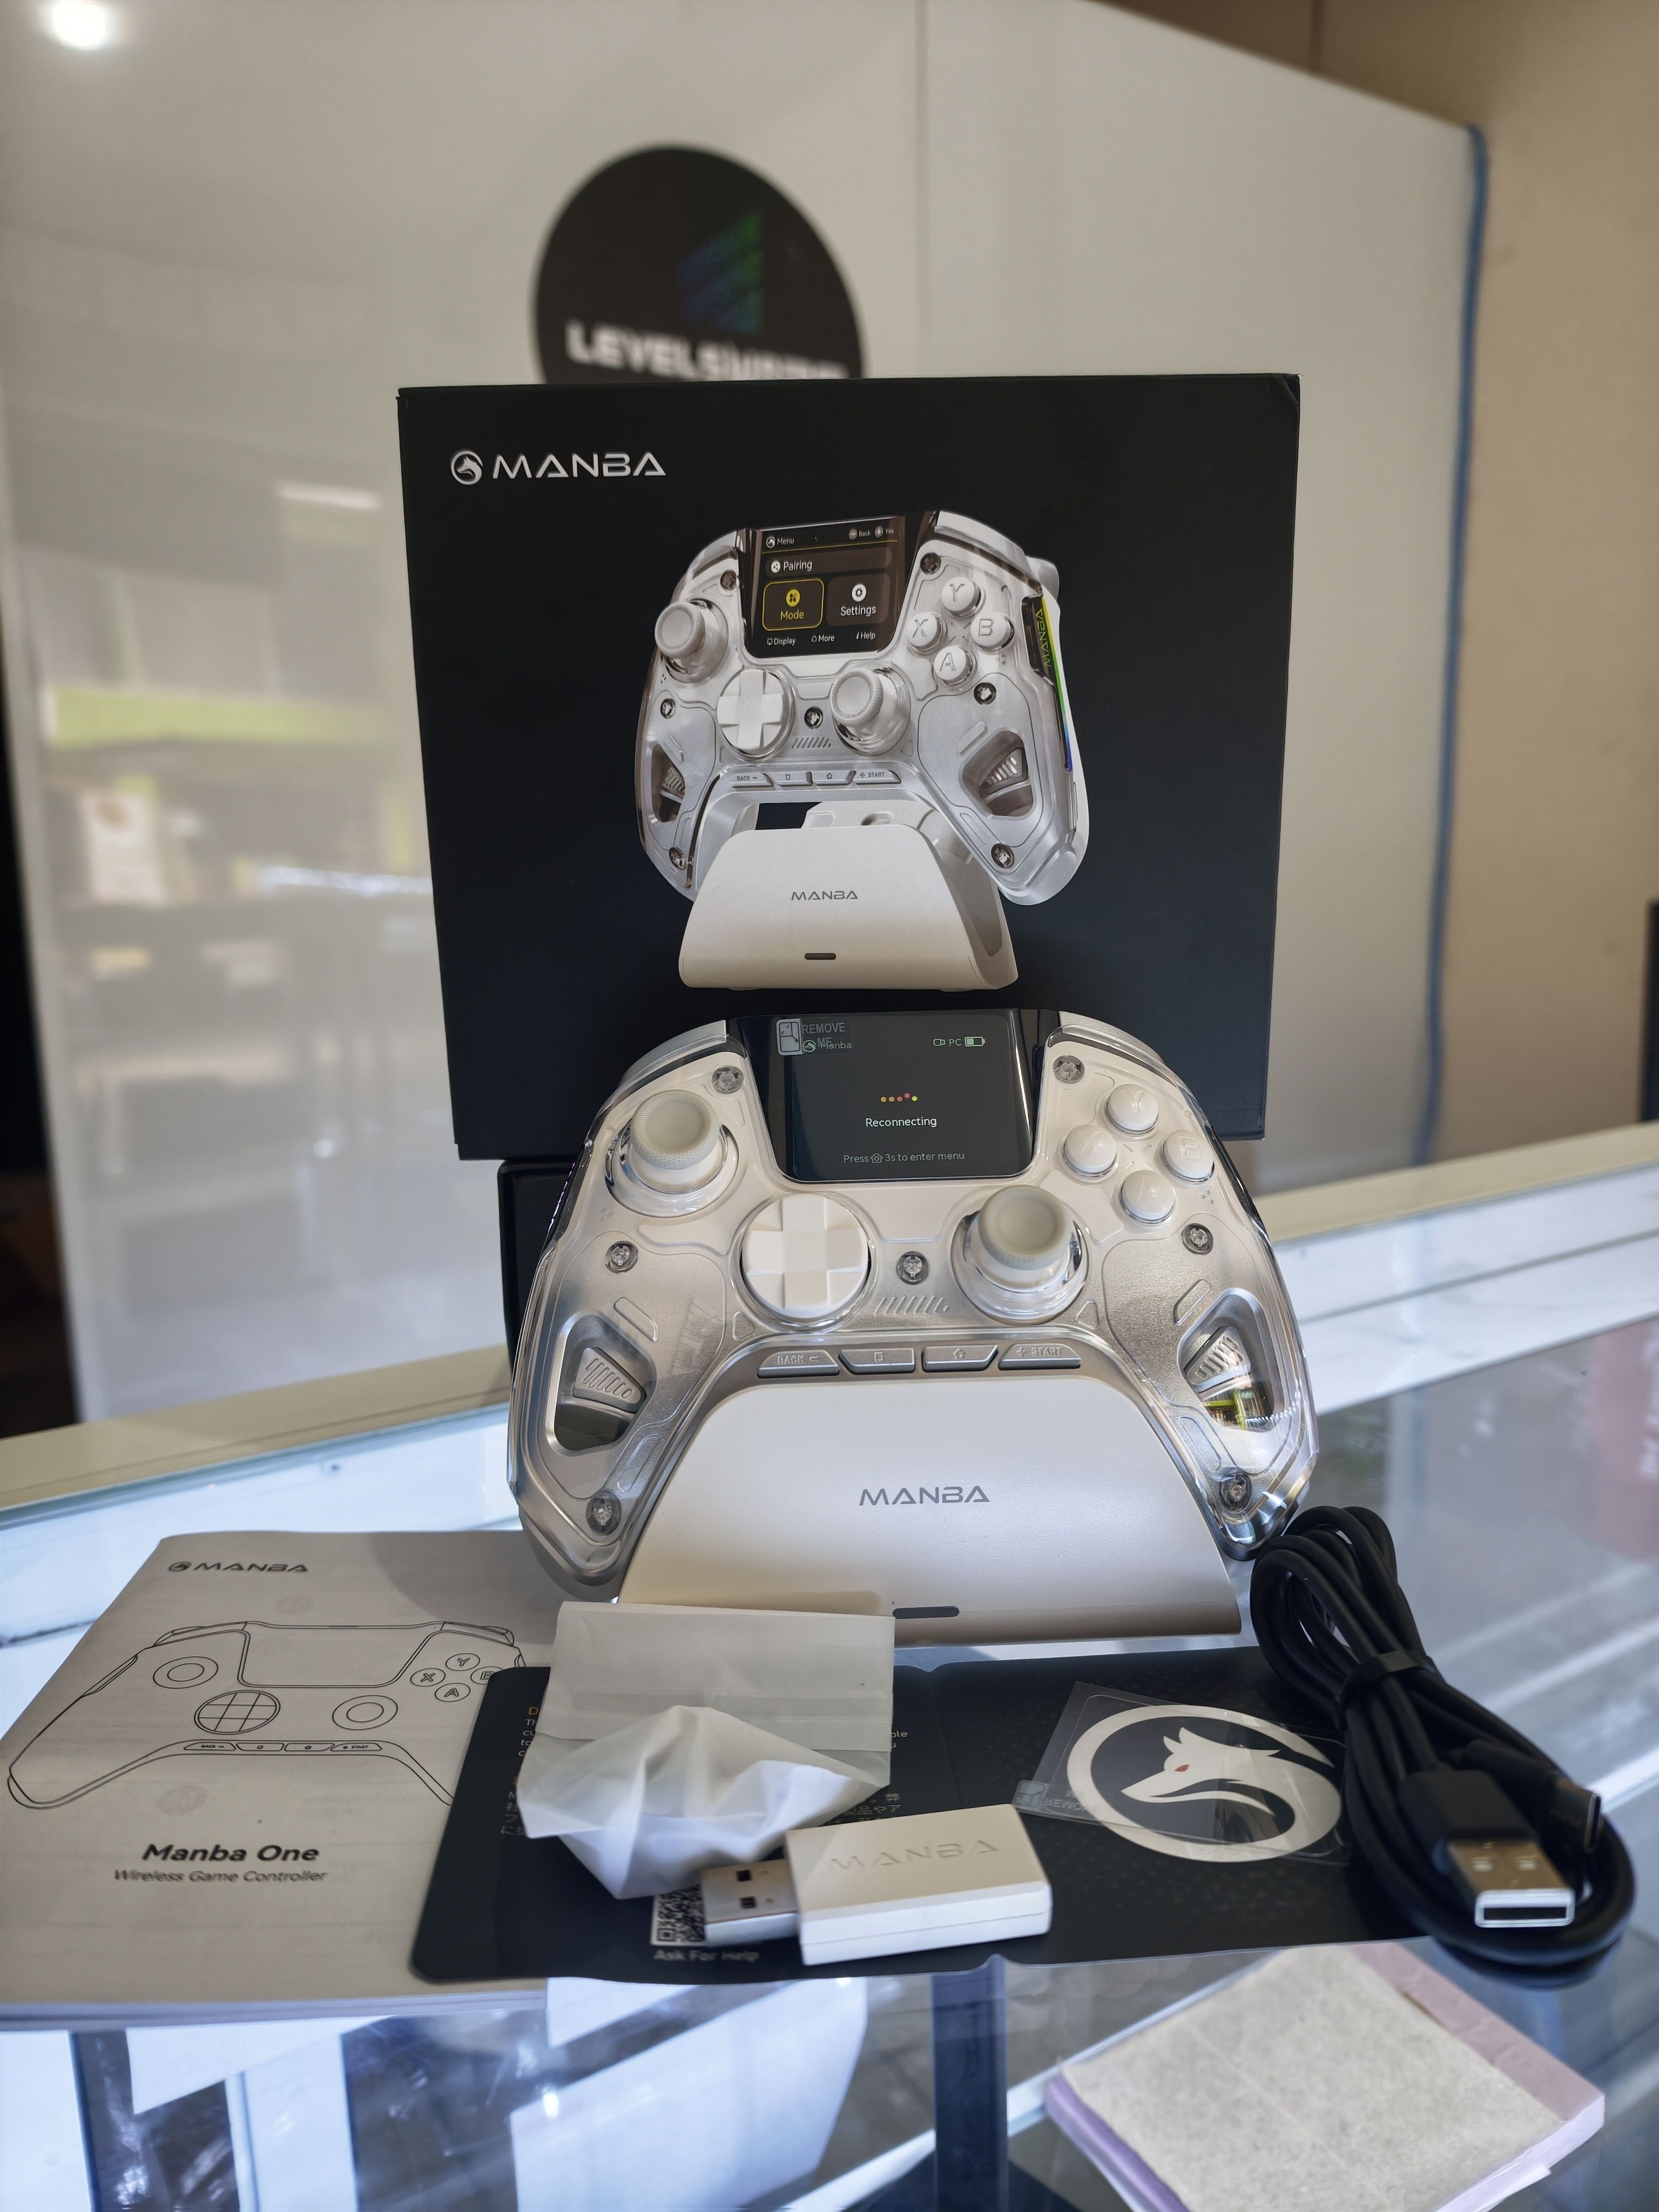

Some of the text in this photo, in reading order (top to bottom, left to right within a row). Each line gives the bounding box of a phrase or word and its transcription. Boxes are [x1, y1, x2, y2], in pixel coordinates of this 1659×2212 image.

[493, 453, 666, 479] MANBA
[783, 560, 812, 571] Pairing
[949, 584, 965, 602] Y
[780, 610, 804, 621] Mode
[840, 605, 876, 617] Settings
[912, 619, 928, 638] X
[978, 618, 994, 637] B
[860, 631, 875, 640] Help
[1035, 608, 1051, 667] MANBA
[773, 637, 796, 646] Display
[940, 652, 957, 671] A
[791, 891, 859, 901] MANBA
[802, 1022, 846, 1035] REMOVE
[820, 1041, 852, 1050] Manba
[949, 1038, 962, 1047] PC
[865, 1117, 937, 1128] Reconnecting
[844, 1155, 869, 1163] Press
[898, 1154, 908, 1162] to
[910, 1154, 935, 1162] enter
[938, 1152, 965, 1161] menu
[859, 1485, 990, 1506] MANBA
[193, 1562, 308, 1572] MANBA
[457, 1657, 471, 1667] Y
[420, 1673, 436, 1682] X
[444, 1688, 460, 1697] A
[141, 1844, 320, 1862] Manba One
[828, 1839, 999, 1871] MANBA
[189, 1870, 239, 1883] Game
[244, 1870, 328, 1883] Controller
